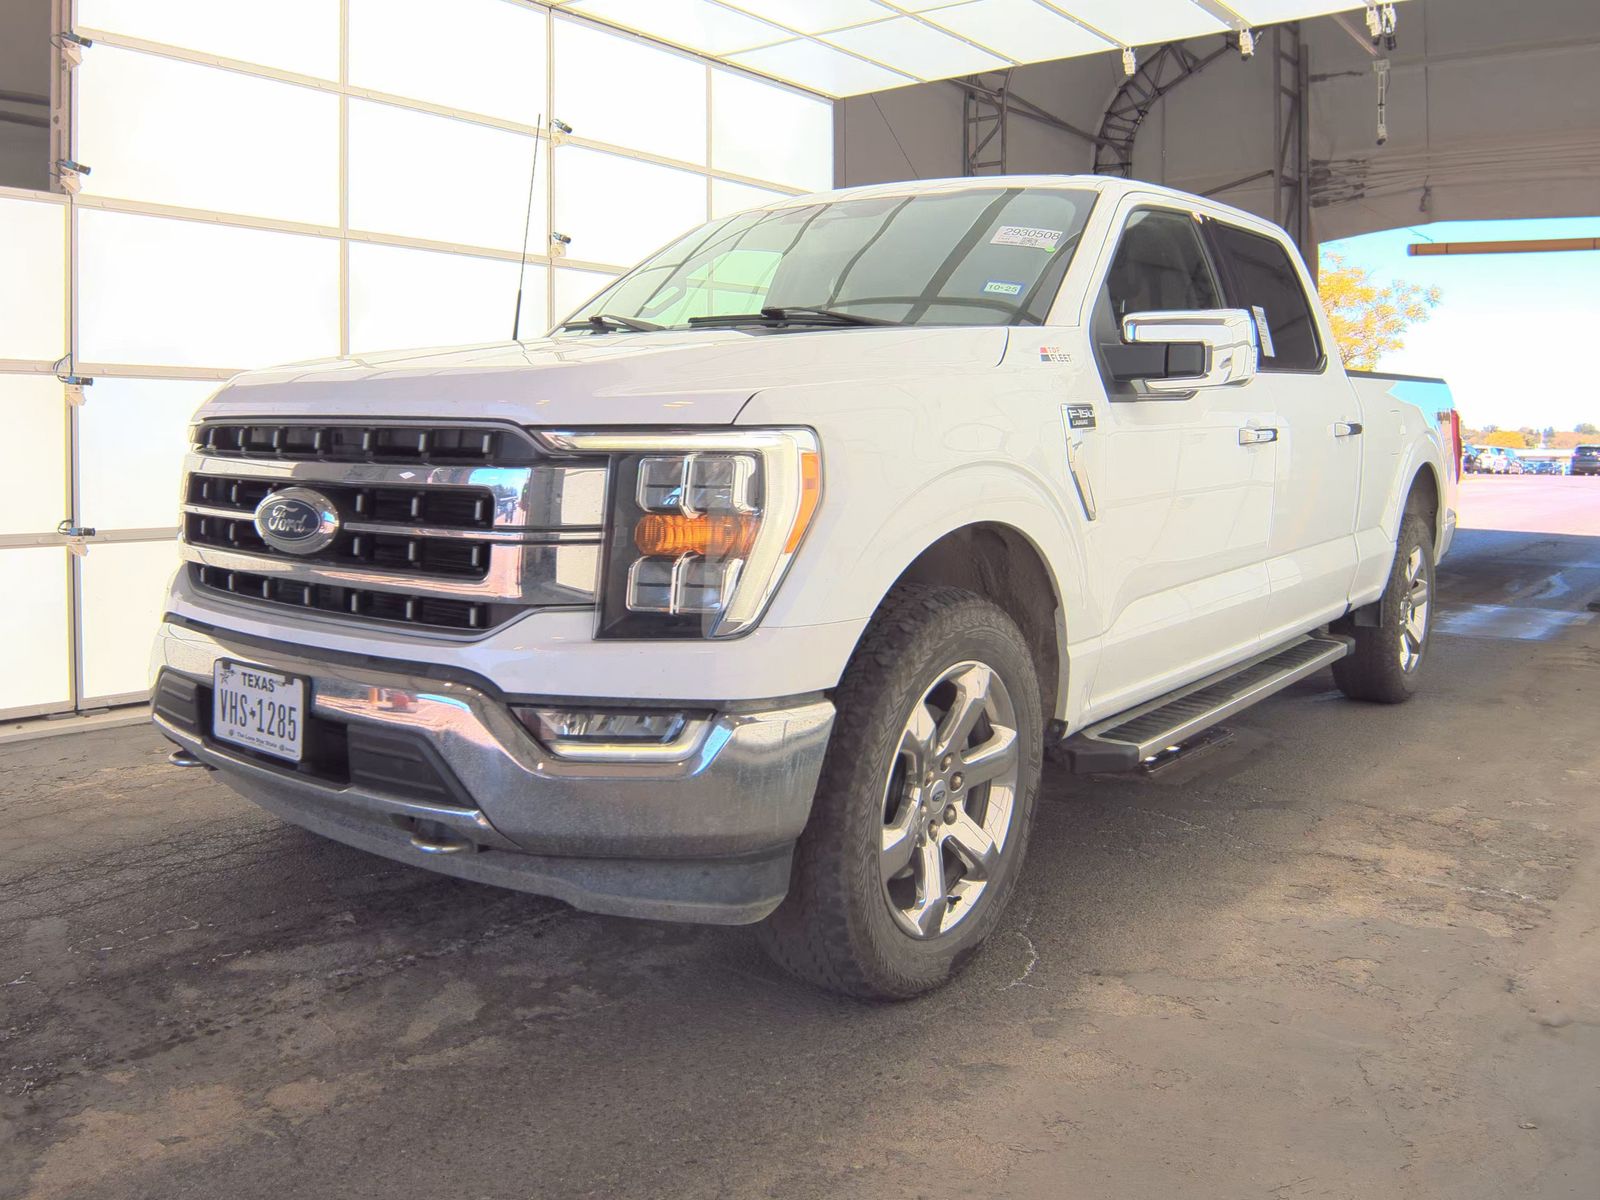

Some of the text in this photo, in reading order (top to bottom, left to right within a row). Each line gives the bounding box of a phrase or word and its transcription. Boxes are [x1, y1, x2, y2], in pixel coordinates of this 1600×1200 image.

[1003, 228, 1061, 240] 2930508
[988, 284, 1018, 293] 10-25
[1051, 354, 1071, 362] FLEET
[1069, 408, 1094, 418] F-150
[268, 505, 307, 533] Ford
[241, 671, 275, 693] TEXAS
